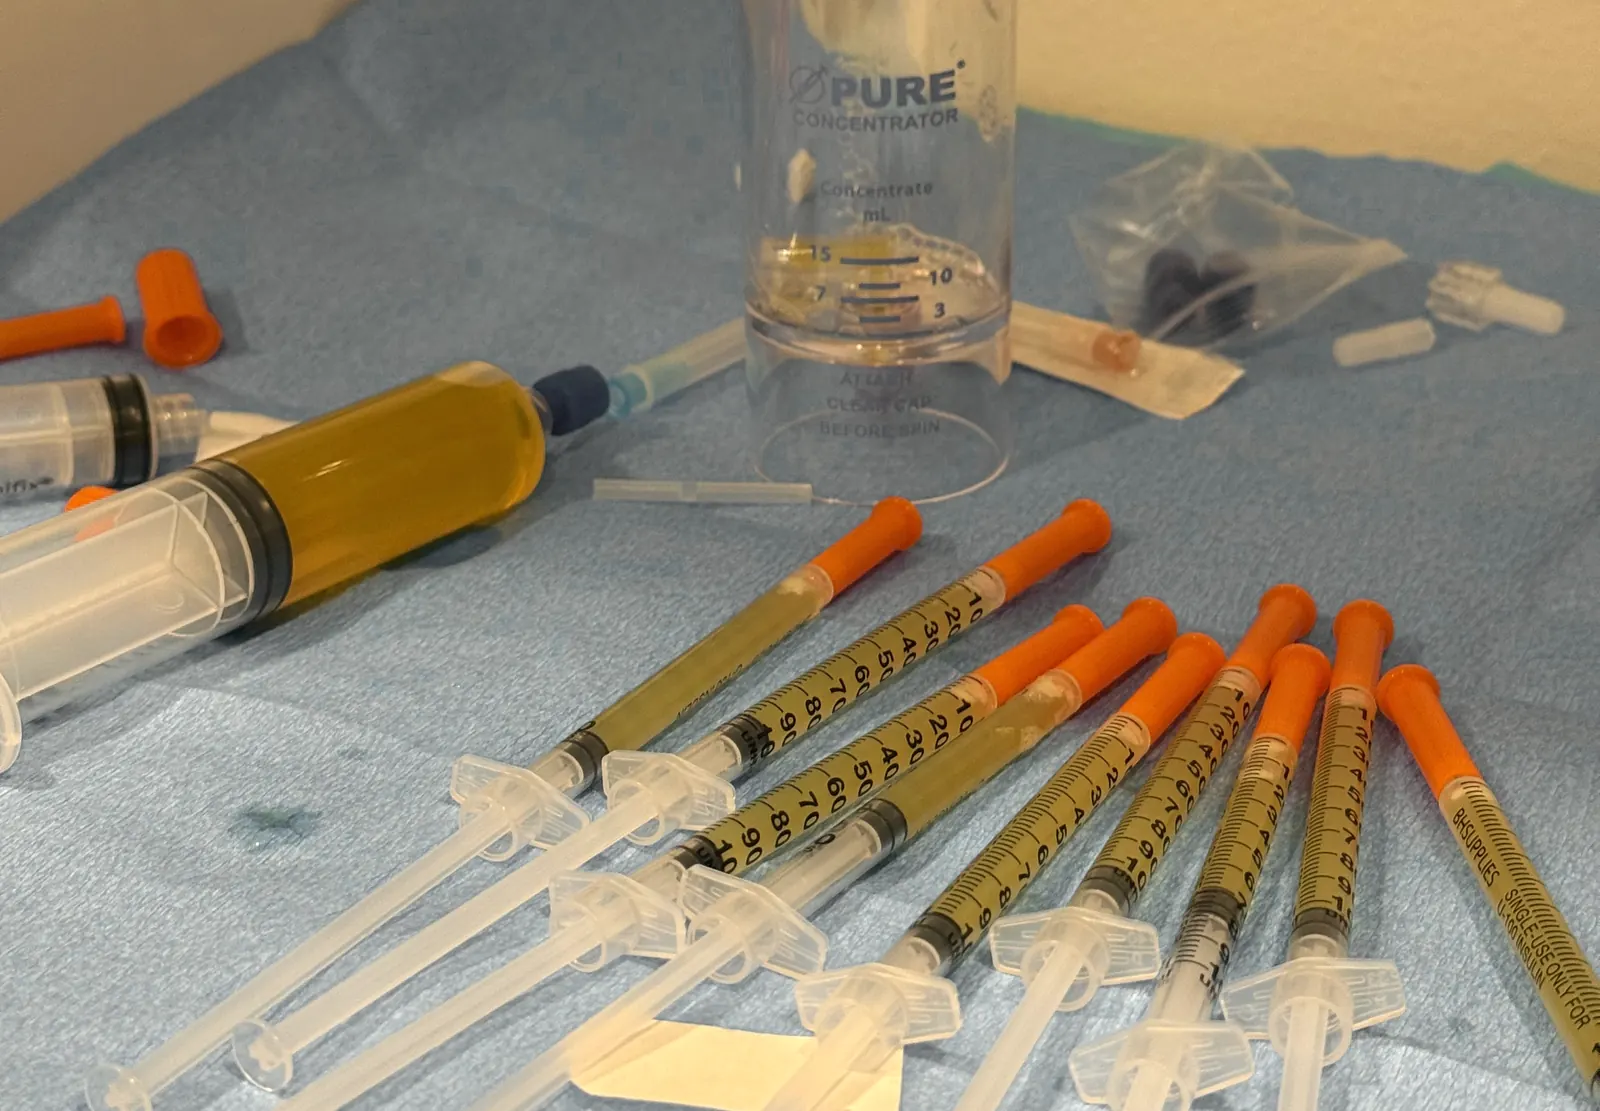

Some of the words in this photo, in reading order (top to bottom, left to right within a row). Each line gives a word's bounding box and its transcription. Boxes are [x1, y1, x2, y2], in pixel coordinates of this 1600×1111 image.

[792, 108, 958, 132] CONCENTRATOR
[820, 181, 934, 199] Concentrate
[863, 207, 890, 222] mL
[811, 245, 831, 262] 15
[814, 285, 826, 301] 7
[929, 267, 953, 286] 10
[934, 302, 945, 318] 3
[944, 606, 961, 639] 20
[968, 592, 983, 624] 10
[902, 637, 917, 668] 40
[924, 620, 939, 653] 30
[855, 665, 870, 698] 60
[878, 650, 894, 682] 50
[805, 696, 821, 730] 80
[830, 678, 847, 715] 70
[1234, 687, 1250, 720] 10
[780, 712, 796, 747] 90
[928, 714, 949, 750] 20
[956, 699, 973, 733] 10
[1220, 705, 1239, 739] 20
[906, 730, 924, 765] 30
[1210, 723, 1228, 757] 30
[881, 747, 899, 781] 40
[1187, 759, 1206, 795] 50
[1199, 744, 1217, 776] 40
[827, 777, 846, 813] 60
[853, 760, 873, 797] 50
[798, 790, 819, 830] 70
[1176, 780, 1194, 814] 60
[771, 810, 791, 848] 80
[1165, 796, 1182, 835] 70
[741, 828, 763, 866] 90
[1151, 819, 1170, 856] 80
[1453, 807, 1500, 887] BHSUPPLIES
[1139, 840, 1157, 878] 90
[1516, 934, 1545, 990] INSULIN
[1546, 963, 1575, 998] ONLY
[1565, 996, 1591, 1030] FOR
